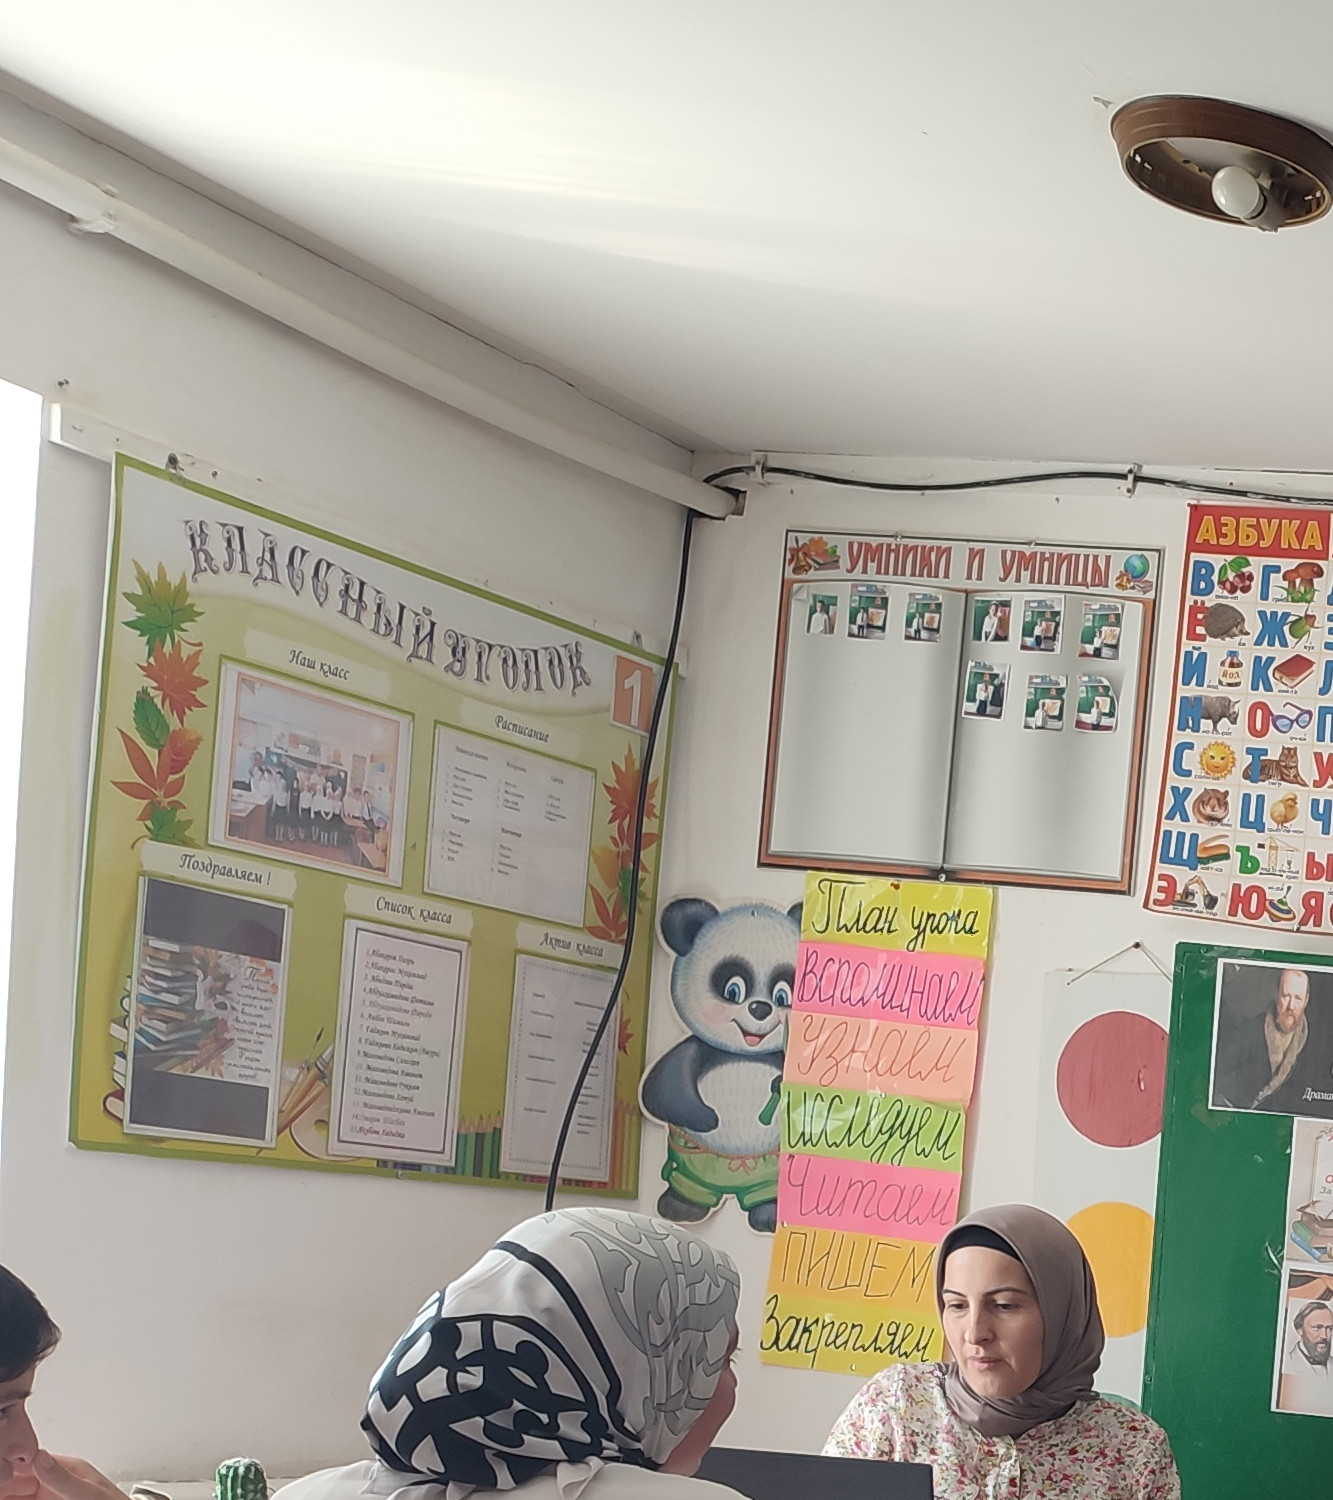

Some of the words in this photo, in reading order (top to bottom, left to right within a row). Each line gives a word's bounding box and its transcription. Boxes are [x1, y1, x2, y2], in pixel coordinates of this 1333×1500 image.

[1195, 515, 1323, 550] АЗБУКА
[846, 540, 953, 580] УМНИКИ
[965, 547, 985, 581] И
[999, 549, 1113, 588] УМНИЦЫ
[1190, 560, 1215, 596] В
[1260, 565, 1281, 601] Г
[183, 520, 437, 664] КЛАССНЫЙ
[443, 628, 592, 697] УГОЛОК
[288, 649, 317, 670] Наш
[319, 660, 351, 681] класс
[624, 668, 643, 728] 1
[494, 715, 550, 743] Расписание
[178, 853, 263, 885] Поздравляем
[376, 896, 416, 921] Список
[419, 906, 452, 925] класса
[811, 877, 899, 936] План
[908, 899, 980, 952] урока
[1299, 891, 1324, 927] Я
[540, 932, 572, 951] Актив
[576, 942, 604, 958] класса
[797, 1015, 967, 1087] Узнаем
[785, 1088, 961, 1167] Исследуем
[786, 1154, 954, 1226] Читаем
[783, 1231, 937, 1302] ПИШЕМ
[761, 1294, 934, 1368] Закрепляем
